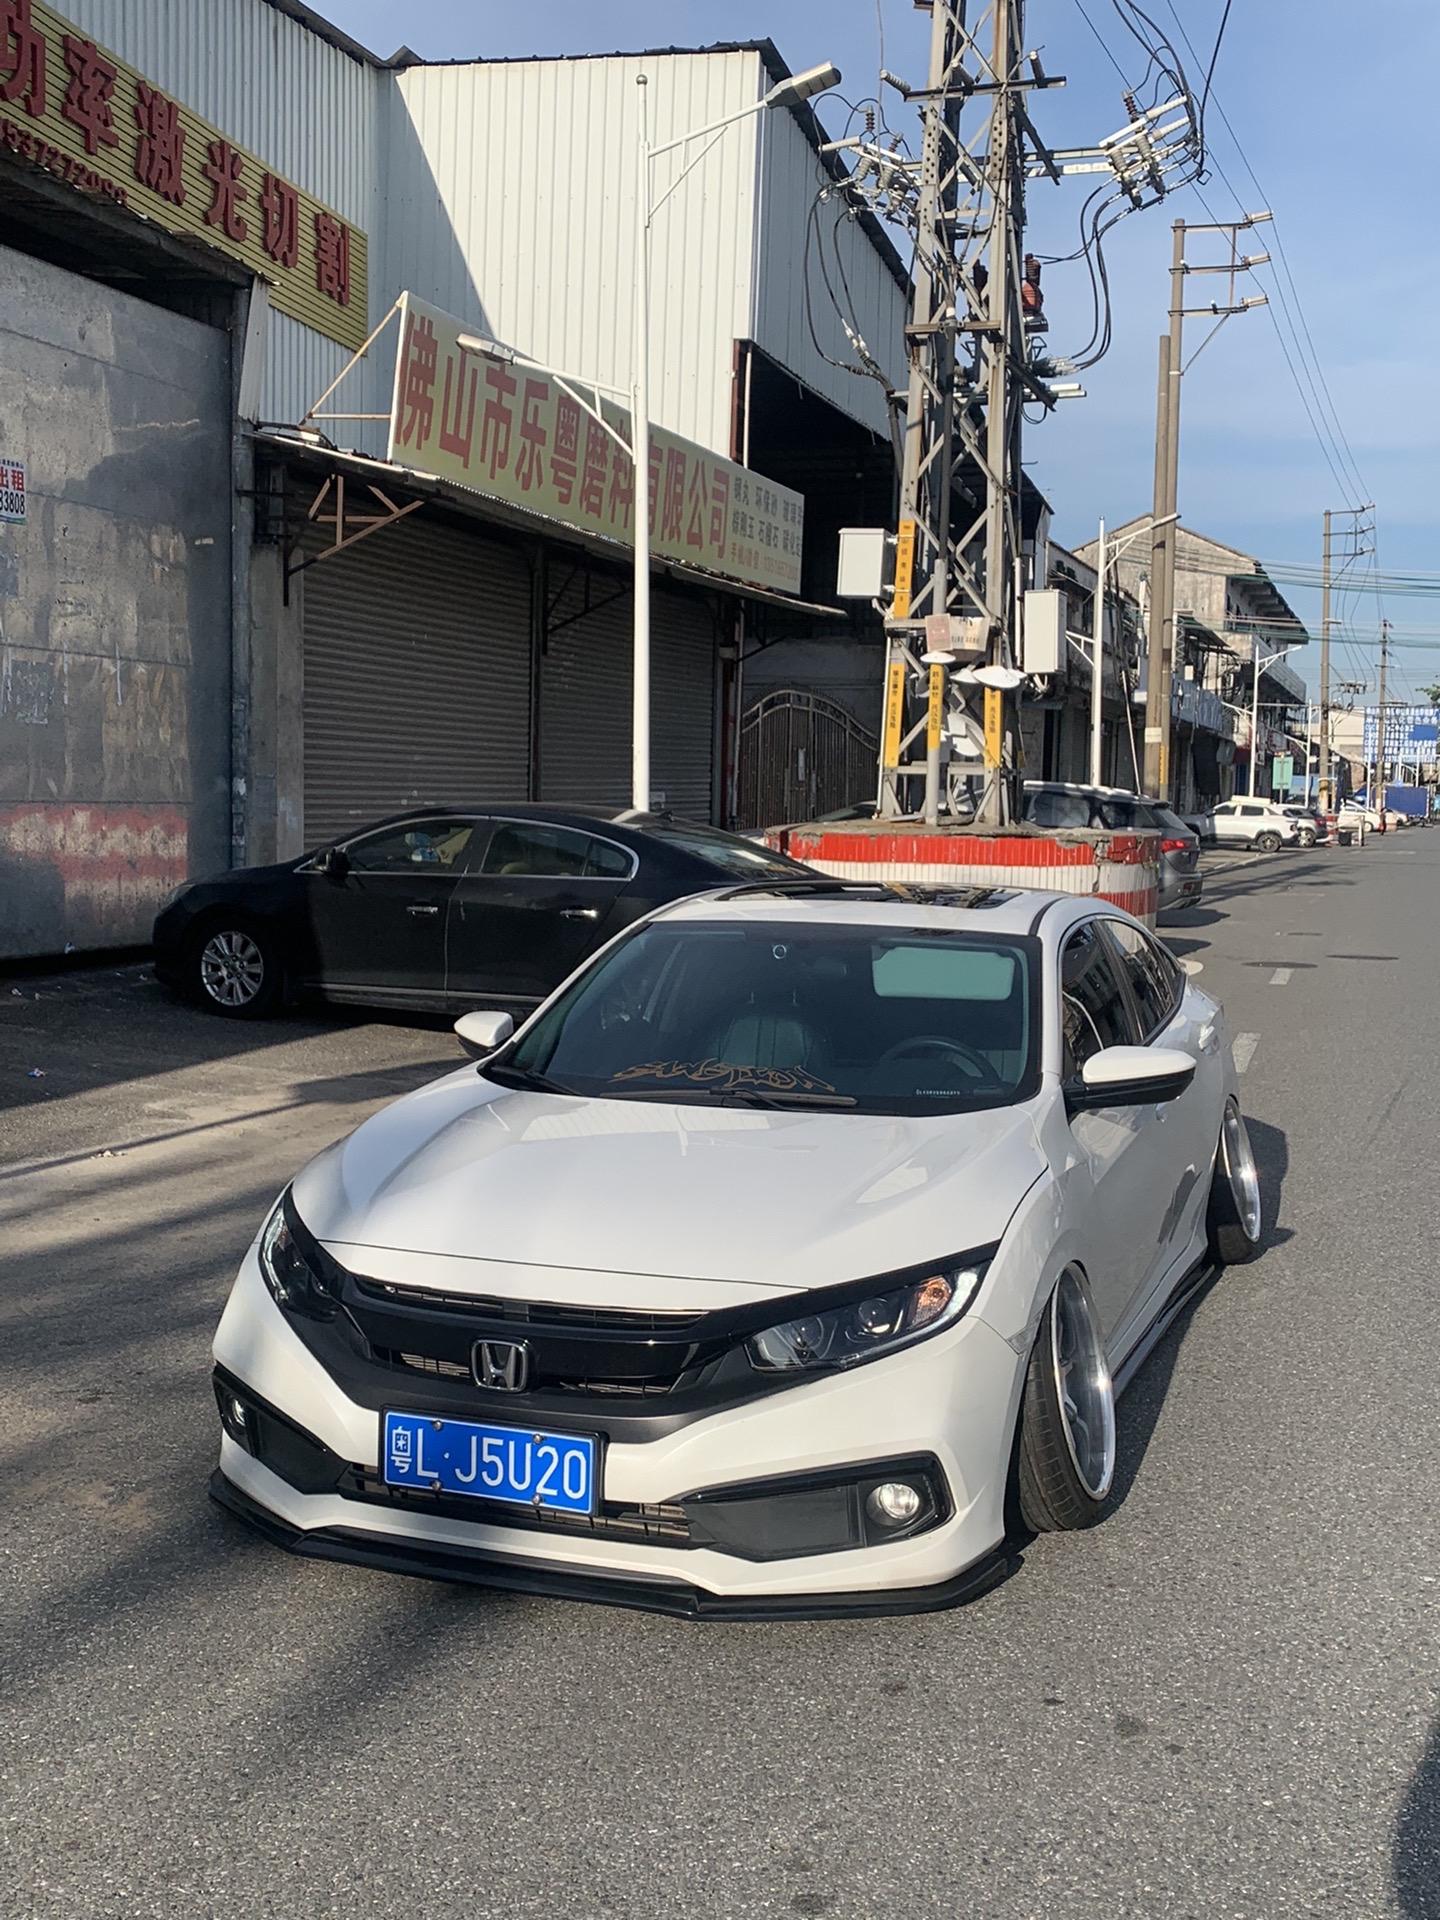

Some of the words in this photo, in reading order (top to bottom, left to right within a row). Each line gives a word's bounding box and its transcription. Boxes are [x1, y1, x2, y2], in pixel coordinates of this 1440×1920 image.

[396, 310, 731, 560] 佛山市乐粤磨料有限公司
